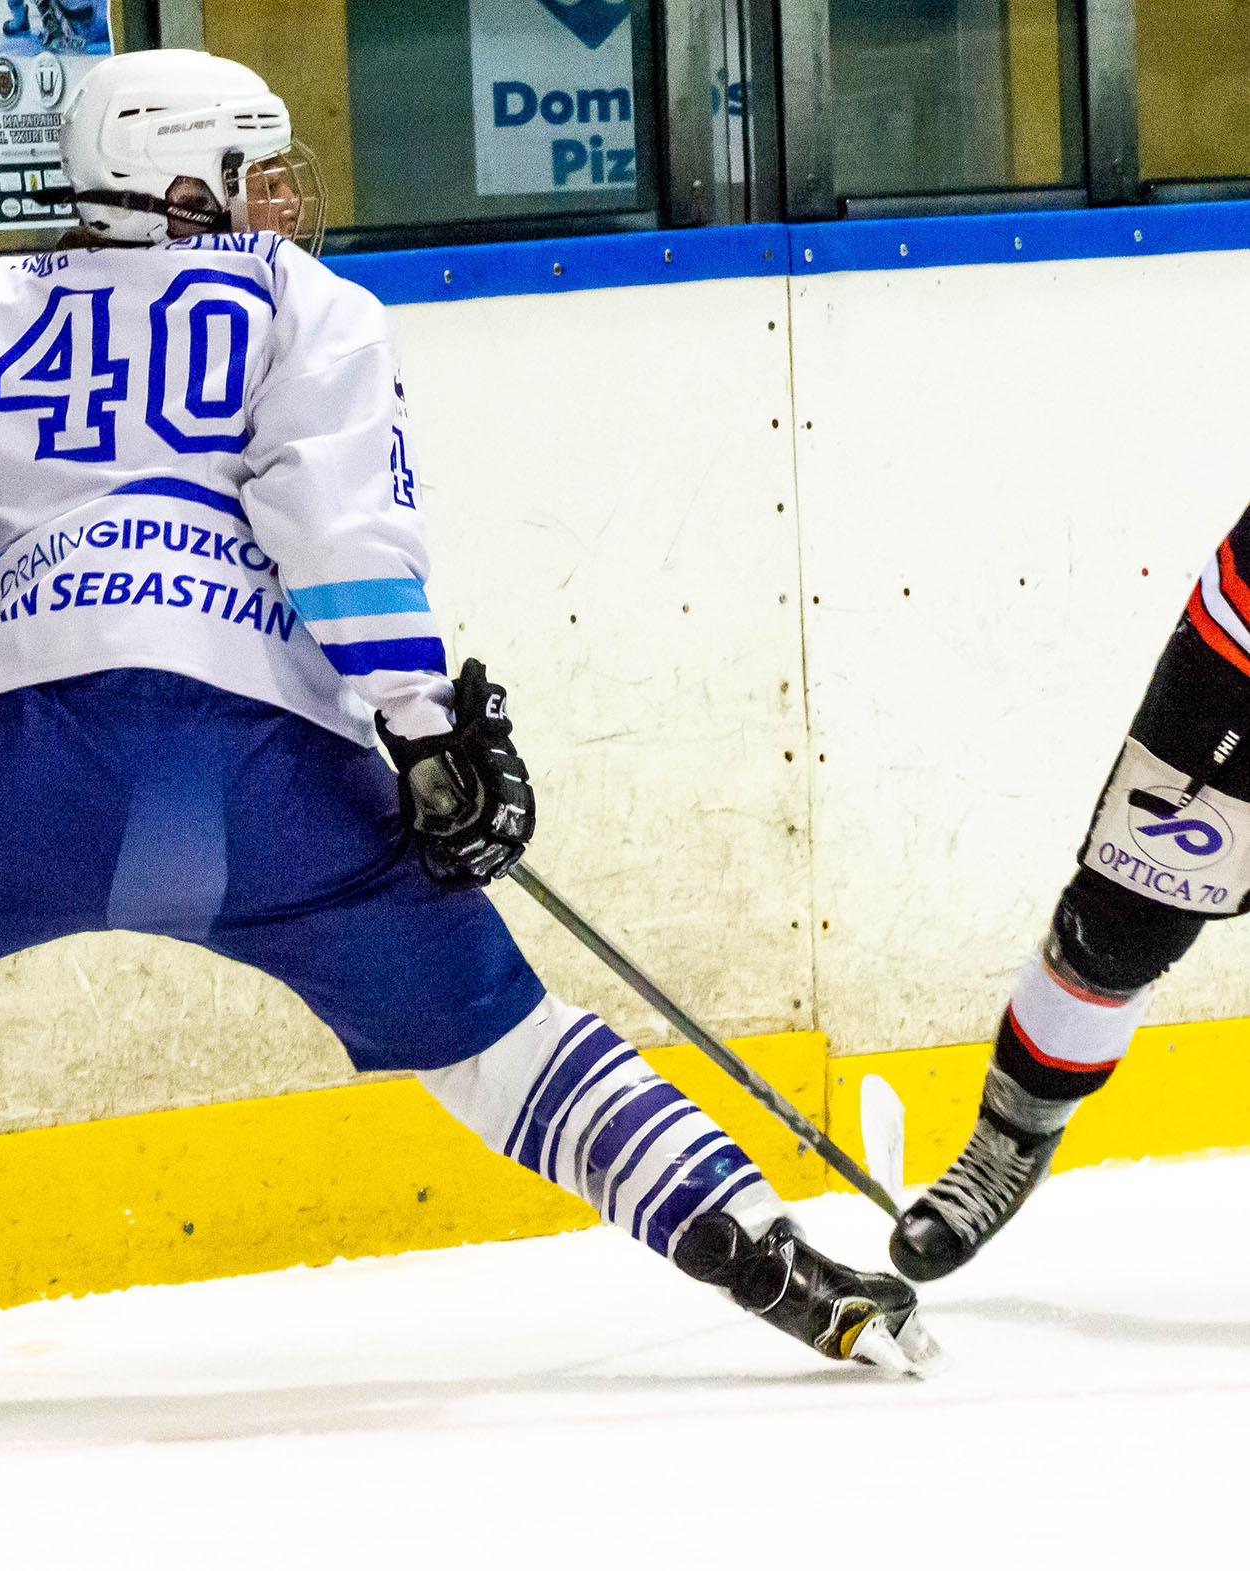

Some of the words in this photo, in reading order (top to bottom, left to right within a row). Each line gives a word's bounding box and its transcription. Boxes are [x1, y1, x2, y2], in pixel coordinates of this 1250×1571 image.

[2, 113, 62, 129] MAJADAHO
[552, 135, 634, 186] Piz
[50, 571, 298, 642] SEBASTIÁN
[1099, 842, 1191, 901] OPTICA
[1201, 885, 1228, 905] 70
